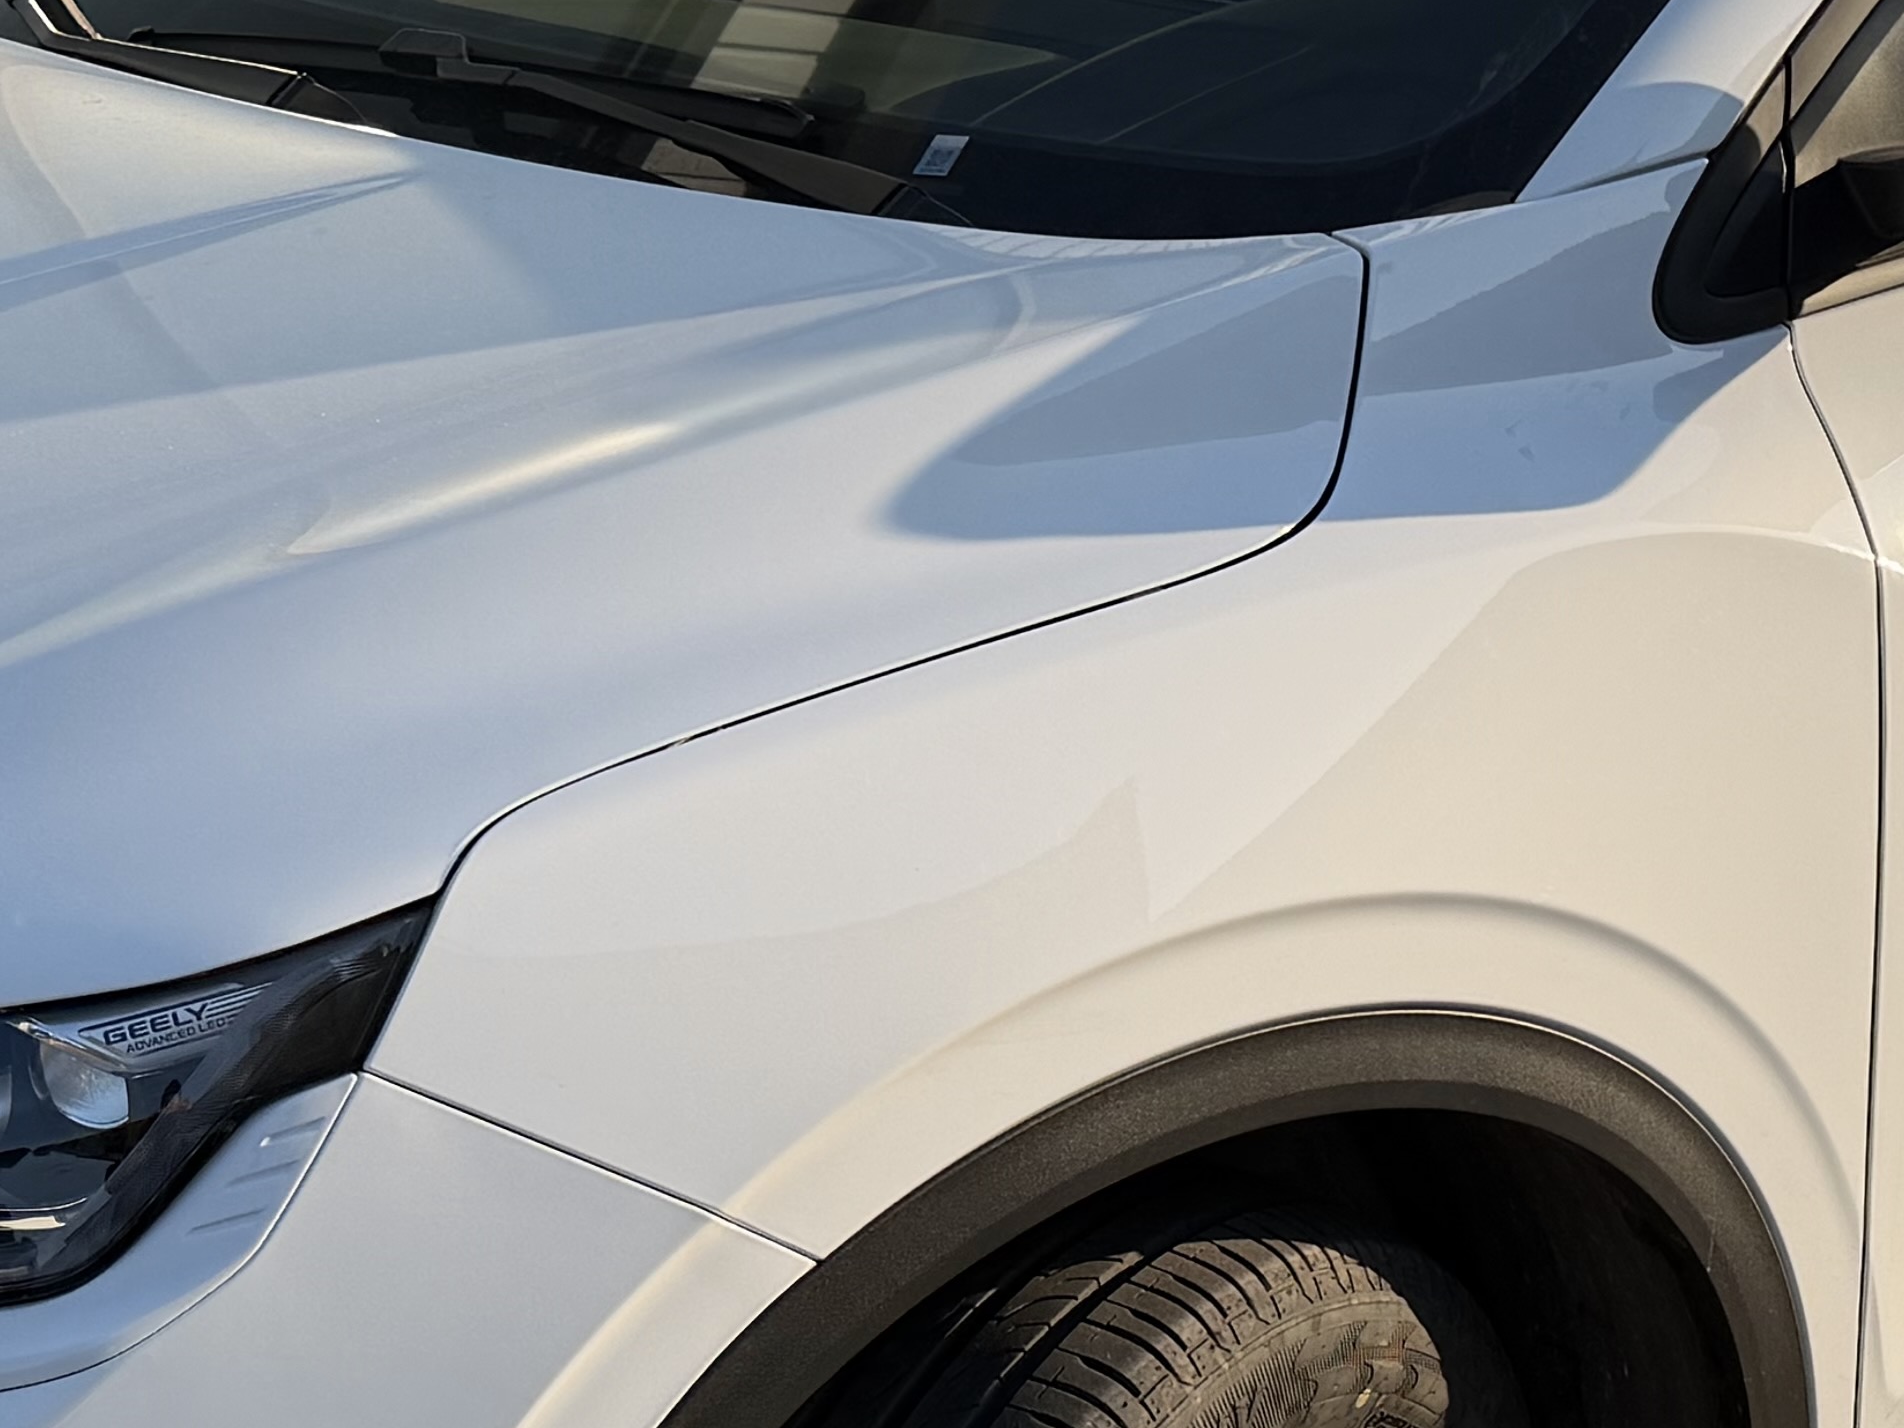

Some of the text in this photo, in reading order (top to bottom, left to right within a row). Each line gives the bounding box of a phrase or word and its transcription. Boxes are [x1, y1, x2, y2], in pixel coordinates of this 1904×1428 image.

[102, 1002, 210, 1046] GEELY
[126, 1016, 227, 1054] ADVANCED LED
